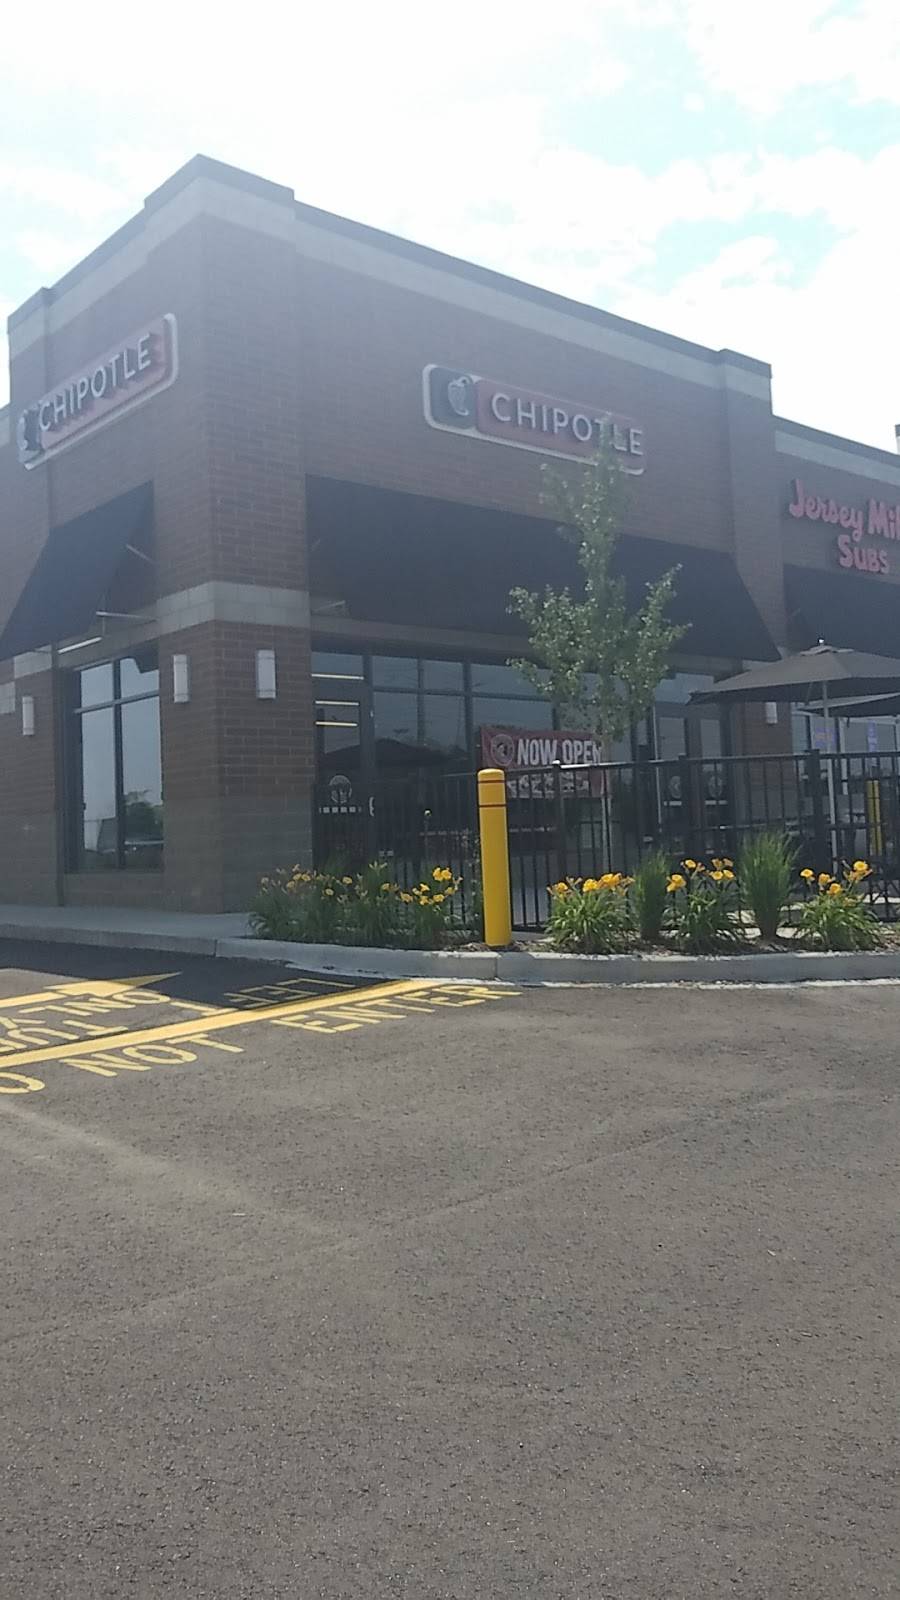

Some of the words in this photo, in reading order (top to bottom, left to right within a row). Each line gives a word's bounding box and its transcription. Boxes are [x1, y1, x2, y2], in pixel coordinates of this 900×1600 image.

[38, 333, 152, 432] CHIPOTLE
[491, 392, 644, 455] CHIPOTLE
[788, 479, 864, 543] Jersey
[516, 738, 558, 766] NOW
[561, 738, 602, 765] OPEN
[58, 1033, 245, 1078] NOT
[269, 985, 523, 1034] ENTER
